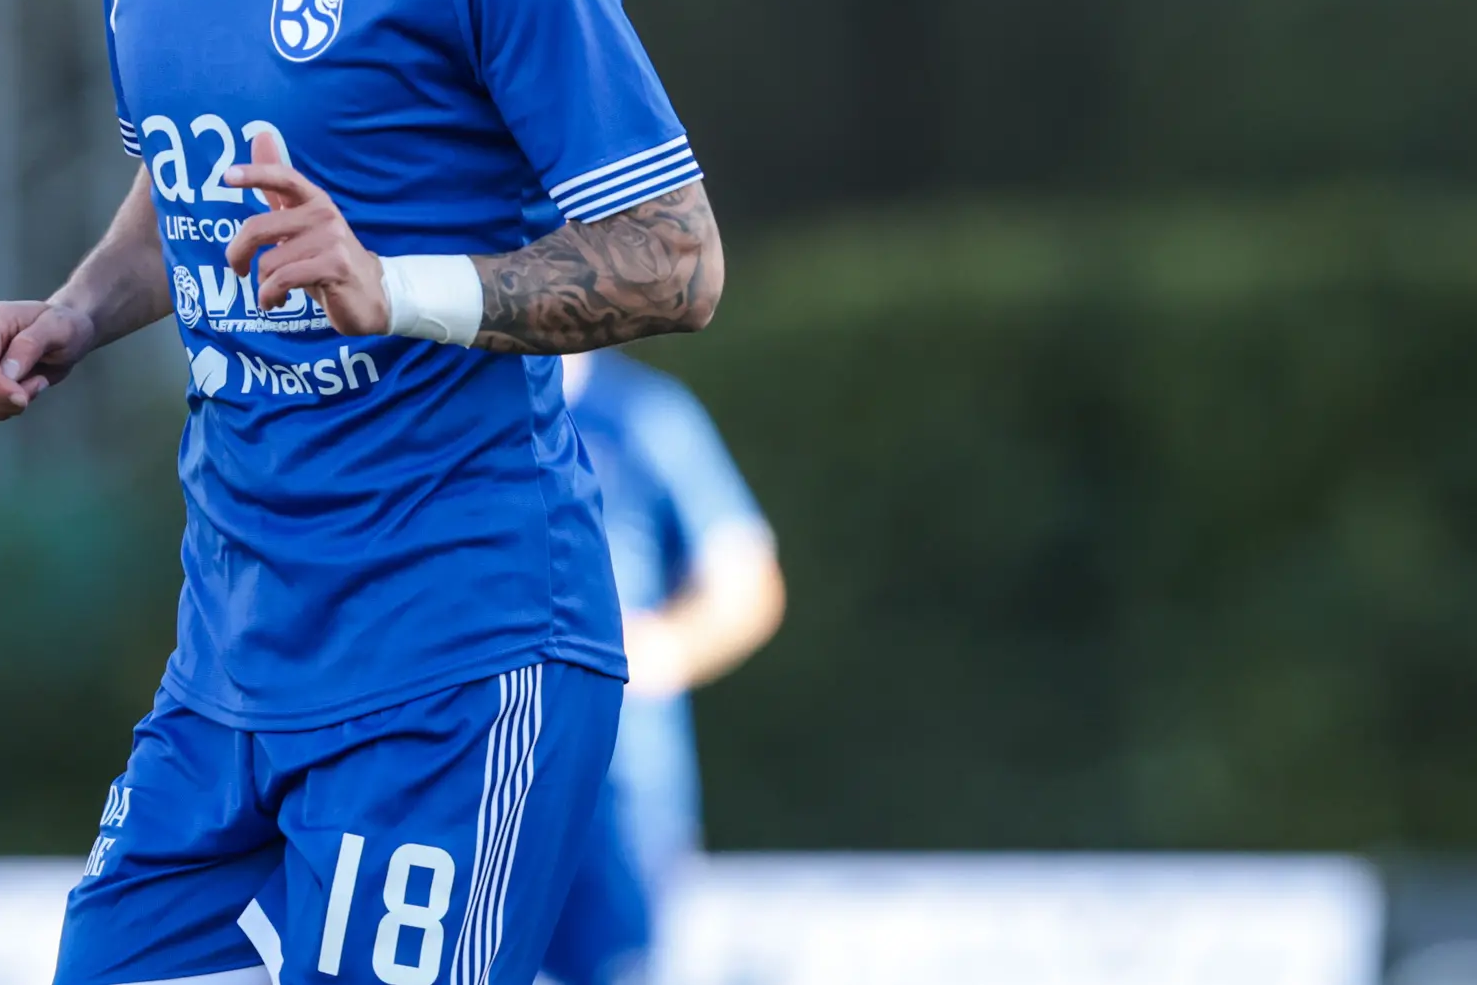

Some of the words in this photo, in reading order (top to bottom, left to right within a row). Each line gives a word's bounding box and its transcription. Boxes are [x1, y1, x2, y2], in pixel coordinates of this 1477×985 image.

[165, 215, 201, 241] LIFE
[236, 345, 380, 396] Marsh
[317, 832, 456, 985] 18
